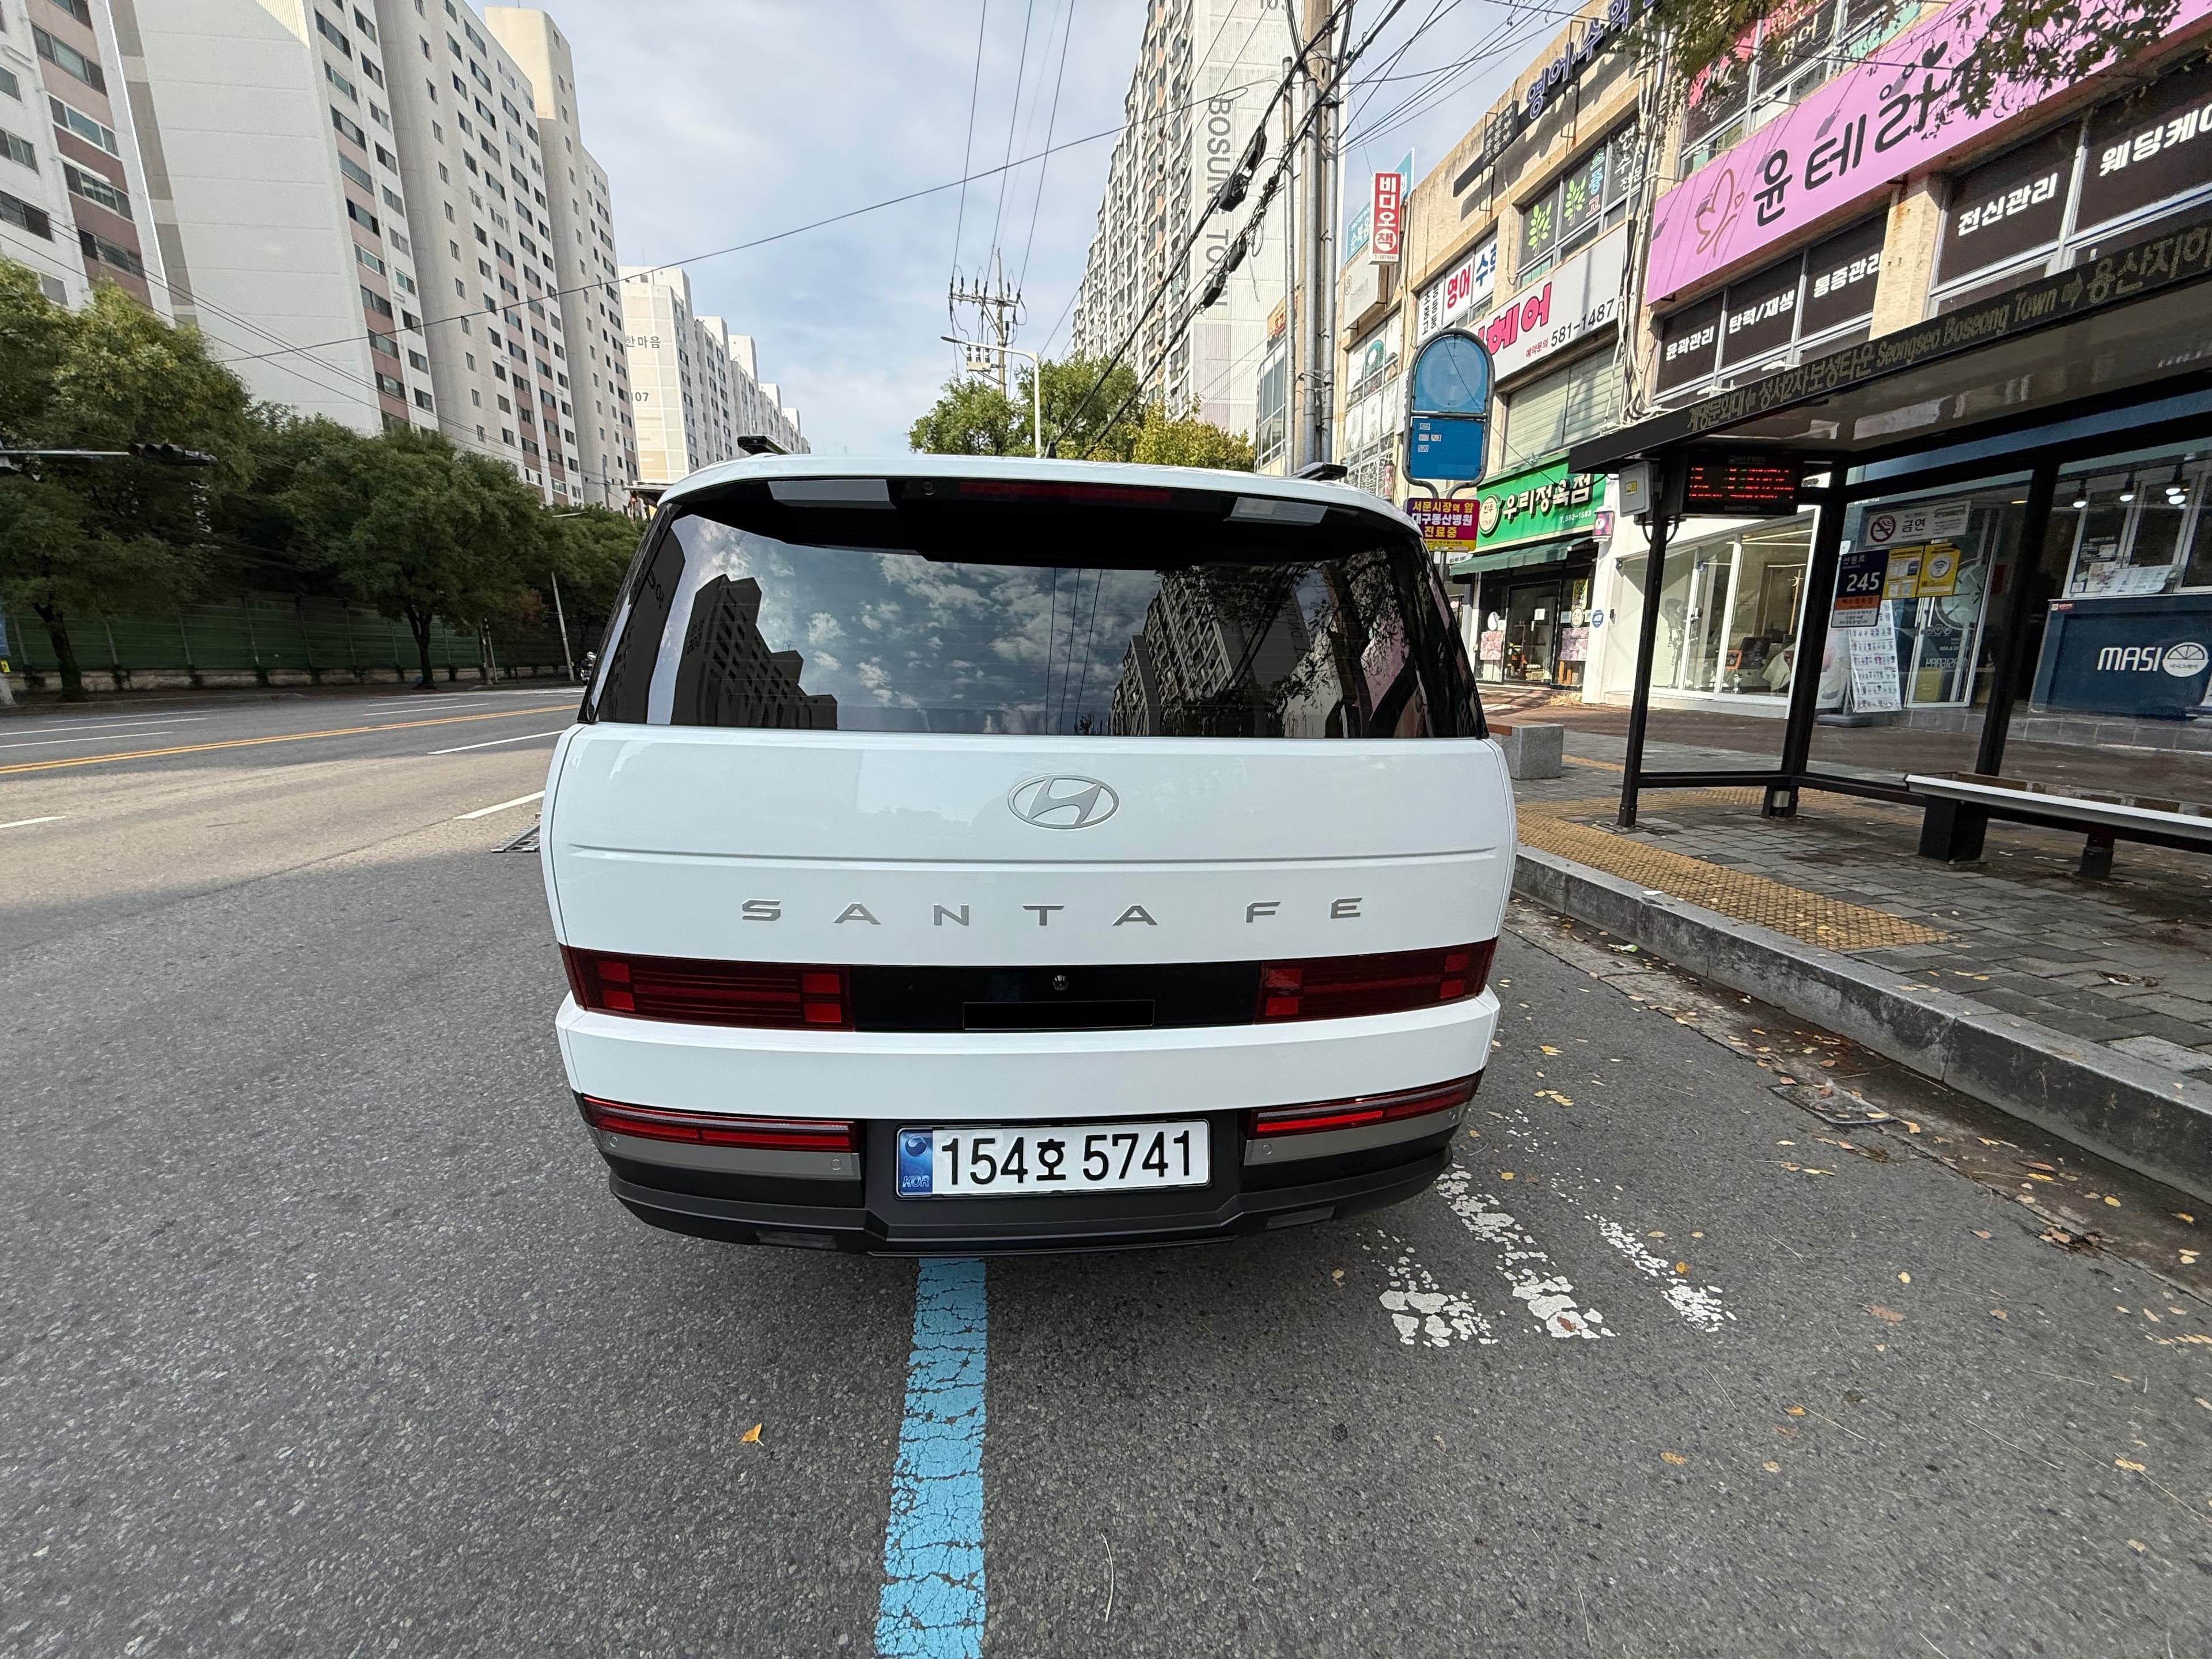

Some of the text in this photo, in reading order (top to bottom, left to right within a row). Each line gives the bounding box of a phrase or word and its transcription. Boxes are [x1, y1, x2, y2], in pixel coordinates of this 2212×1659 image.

[1377, 176, 1397, 248] 비디오 책
[1957, 172, 2059, 237] 전신관리
[1447, 263, 1472, 309] 영어
[1729, 289, 1795, 334] 탄력/재생
[2014, 288, 2058, 322] Town
[1551, 298, 1615, 347] 581-1487
[624, 335, 661, 349] 한마음
[1665, 325, 1714, 361] 윤곽관리
[1412, 501, 1474, 513] 서문시장역 앞
[1503, 474, 1592, 520] 우리정육점
[1411, 512, 1472, 527] 대구동산병원
[1424, 525, 1457, 539] 진료중
[1903, 518, 1926, 533] 금연
[1846, 572, 1881, 592] 245
[2097, 646, 2163, 672] MASI
[741, 897, 1362, 926] SANTA FE
[1082, 1130, 1191, 1181] 5741
[902, 1175, 930, 1188] KOR
